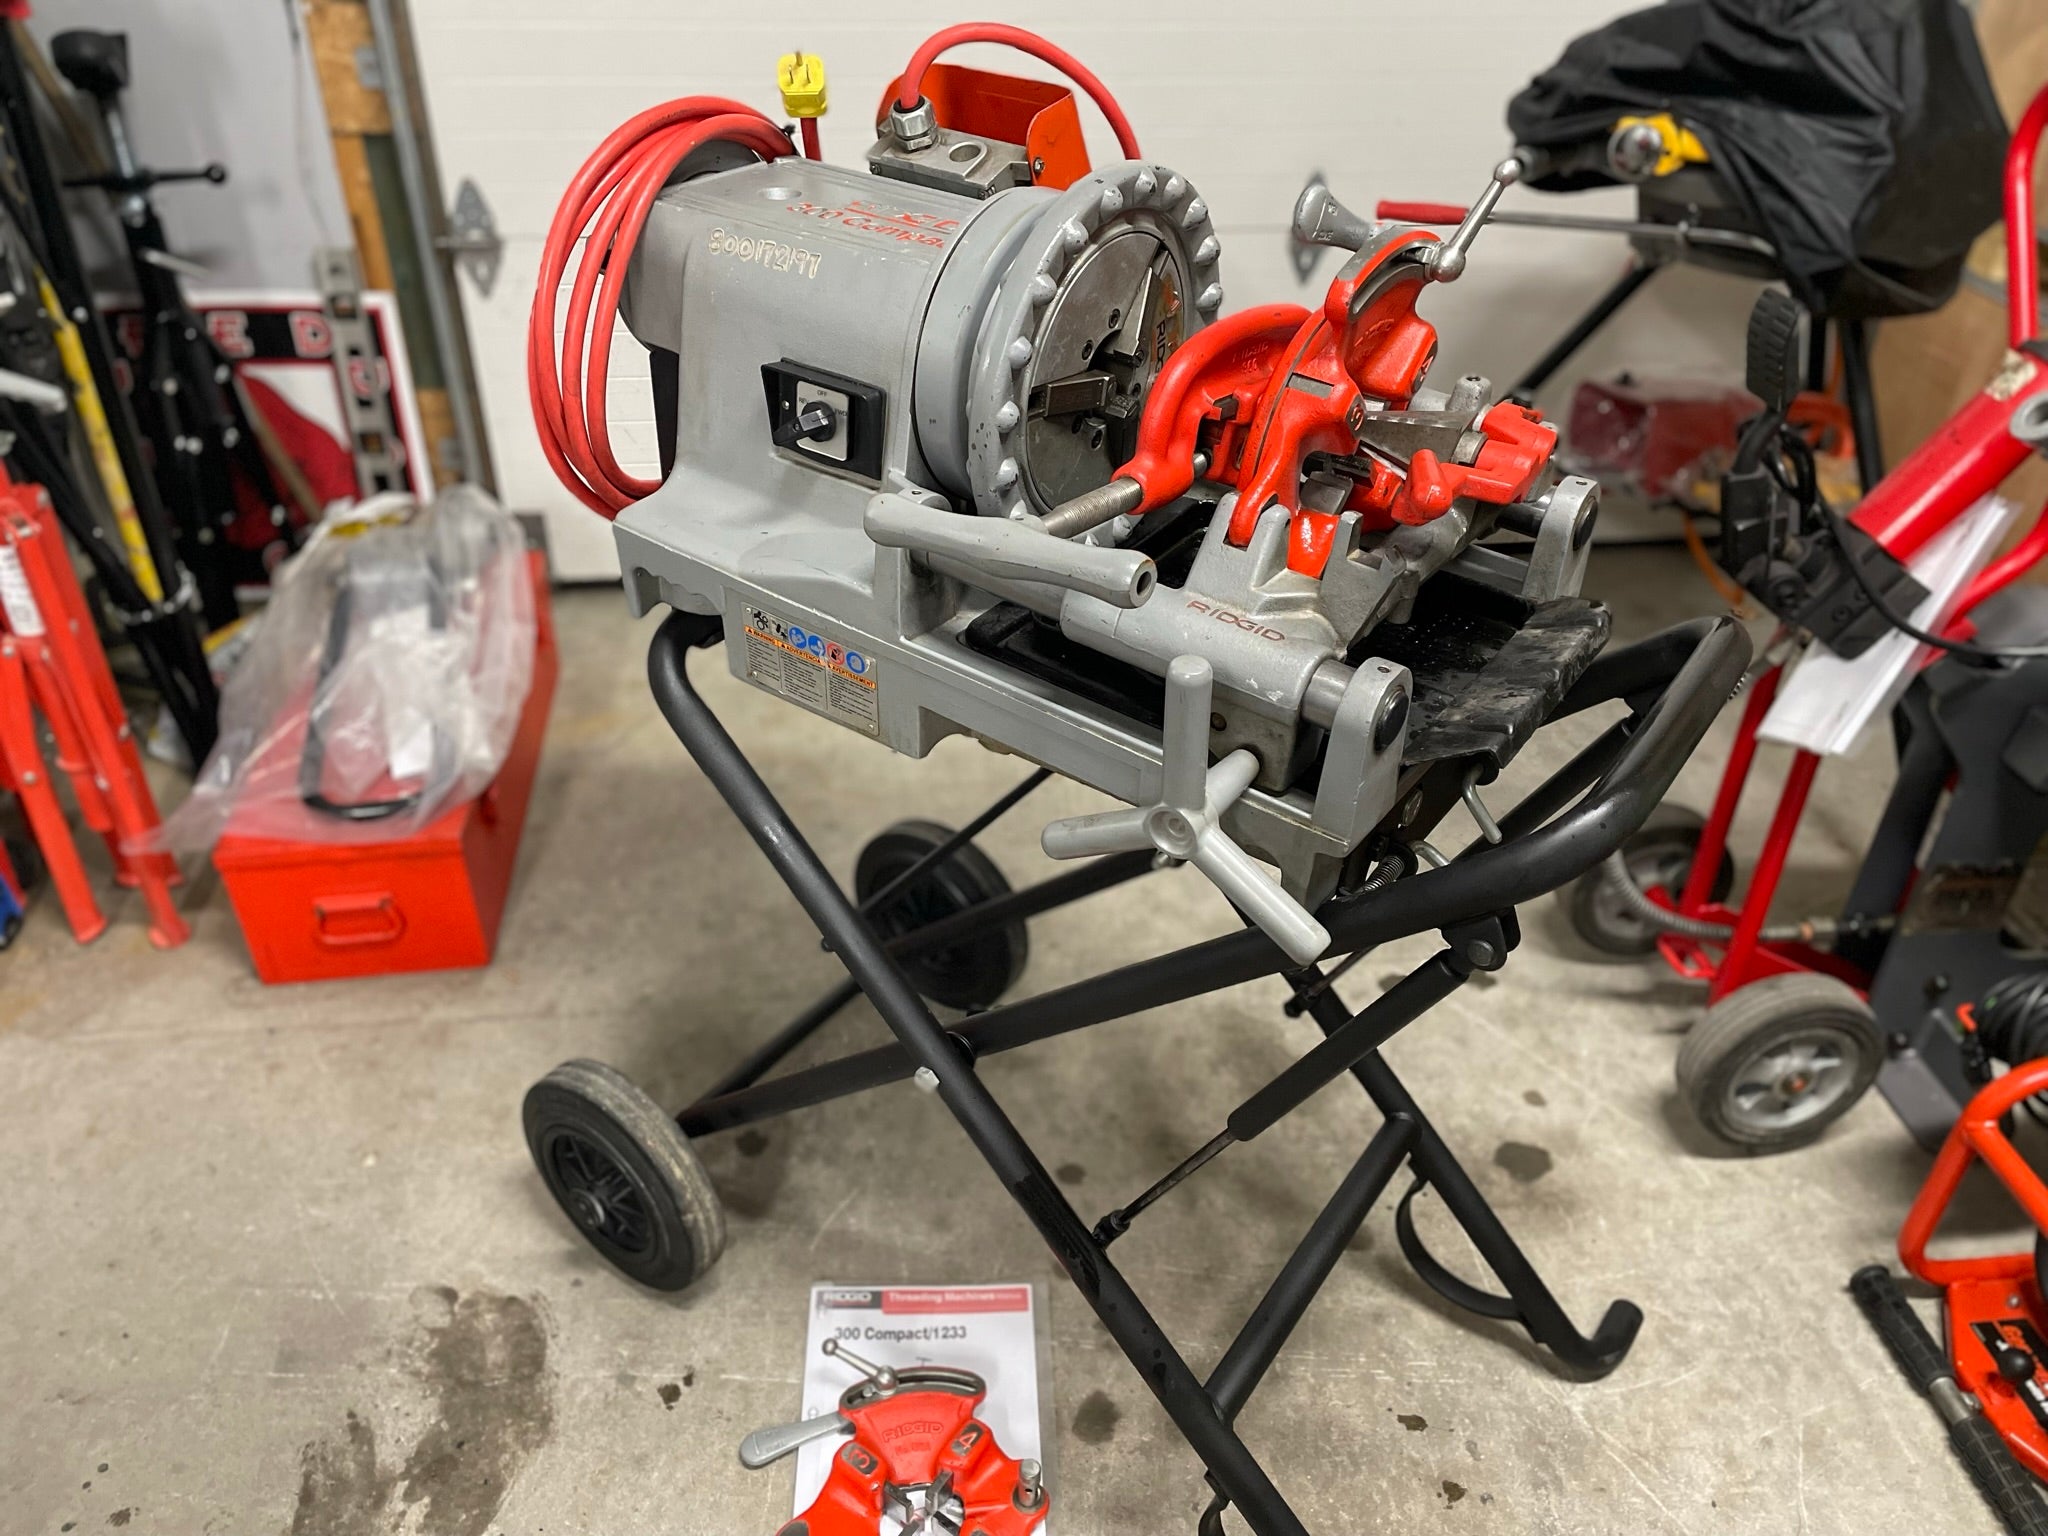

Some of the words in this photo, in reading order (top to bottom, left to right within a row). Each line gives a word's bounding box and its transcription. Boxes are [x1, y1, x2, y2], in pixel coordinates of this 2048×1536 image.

[786, 202, 844, 219] 300
[842, 216, 945, 249] Compa
[1155, 321, 1166, 374] RIDG
[1187, 600, 1286, 641] RIDGID
[753, 630, 777, 647] WARNING
[889, 1291, 942, 1303] Threading
[833, 1326, 861, 1341] 300
[864, 1325, 967, 1343] Compact/1233
[882, 1421, 944, 1442] RIDGID
[959, 1431, 978, 1450] 4
[849, 1449, 871, 1469] 3
